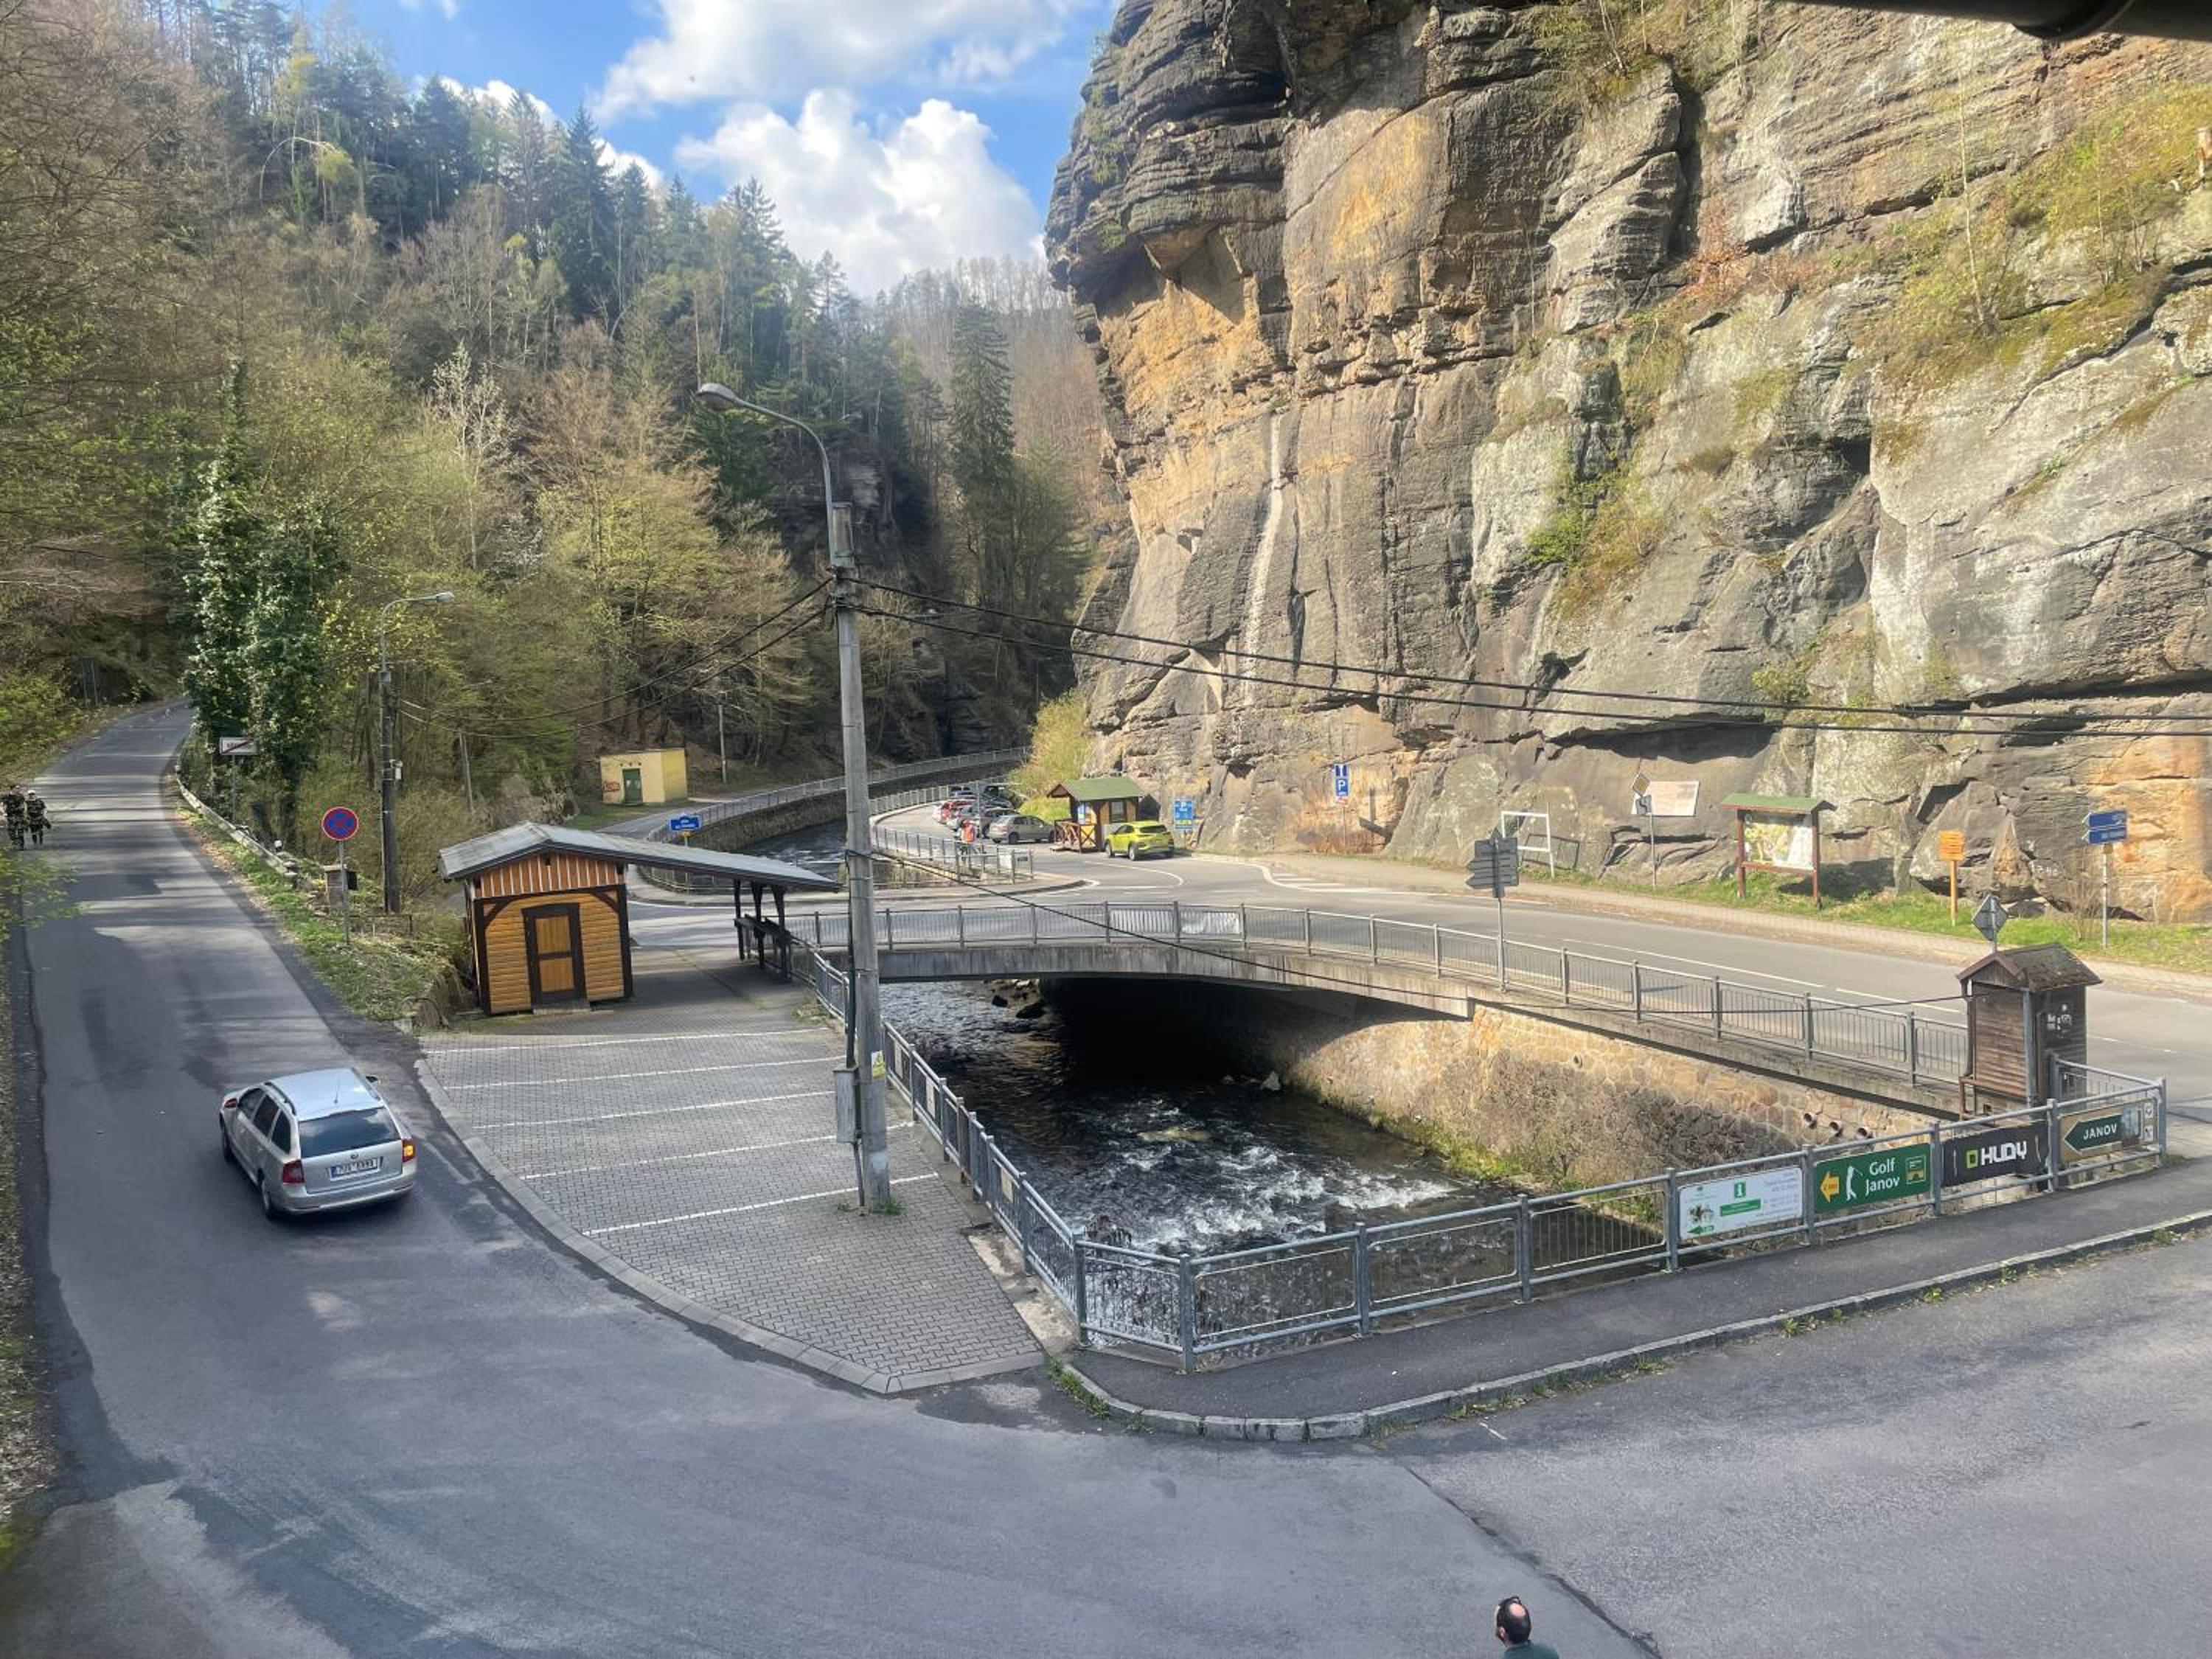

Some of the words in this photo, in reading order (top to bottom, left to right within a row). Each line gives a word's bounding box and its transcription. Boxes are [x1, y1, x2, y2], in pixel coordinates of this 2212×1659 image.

[1338, 779, 1346, 791] P
[2083, 1123, 2118, 1141] JANOV
[1980, 1141, 2027, 1166] HUDY
[1869, 1157, 1896, 1176] Golf
[1865, 1176, 1900, 1197] Janov
